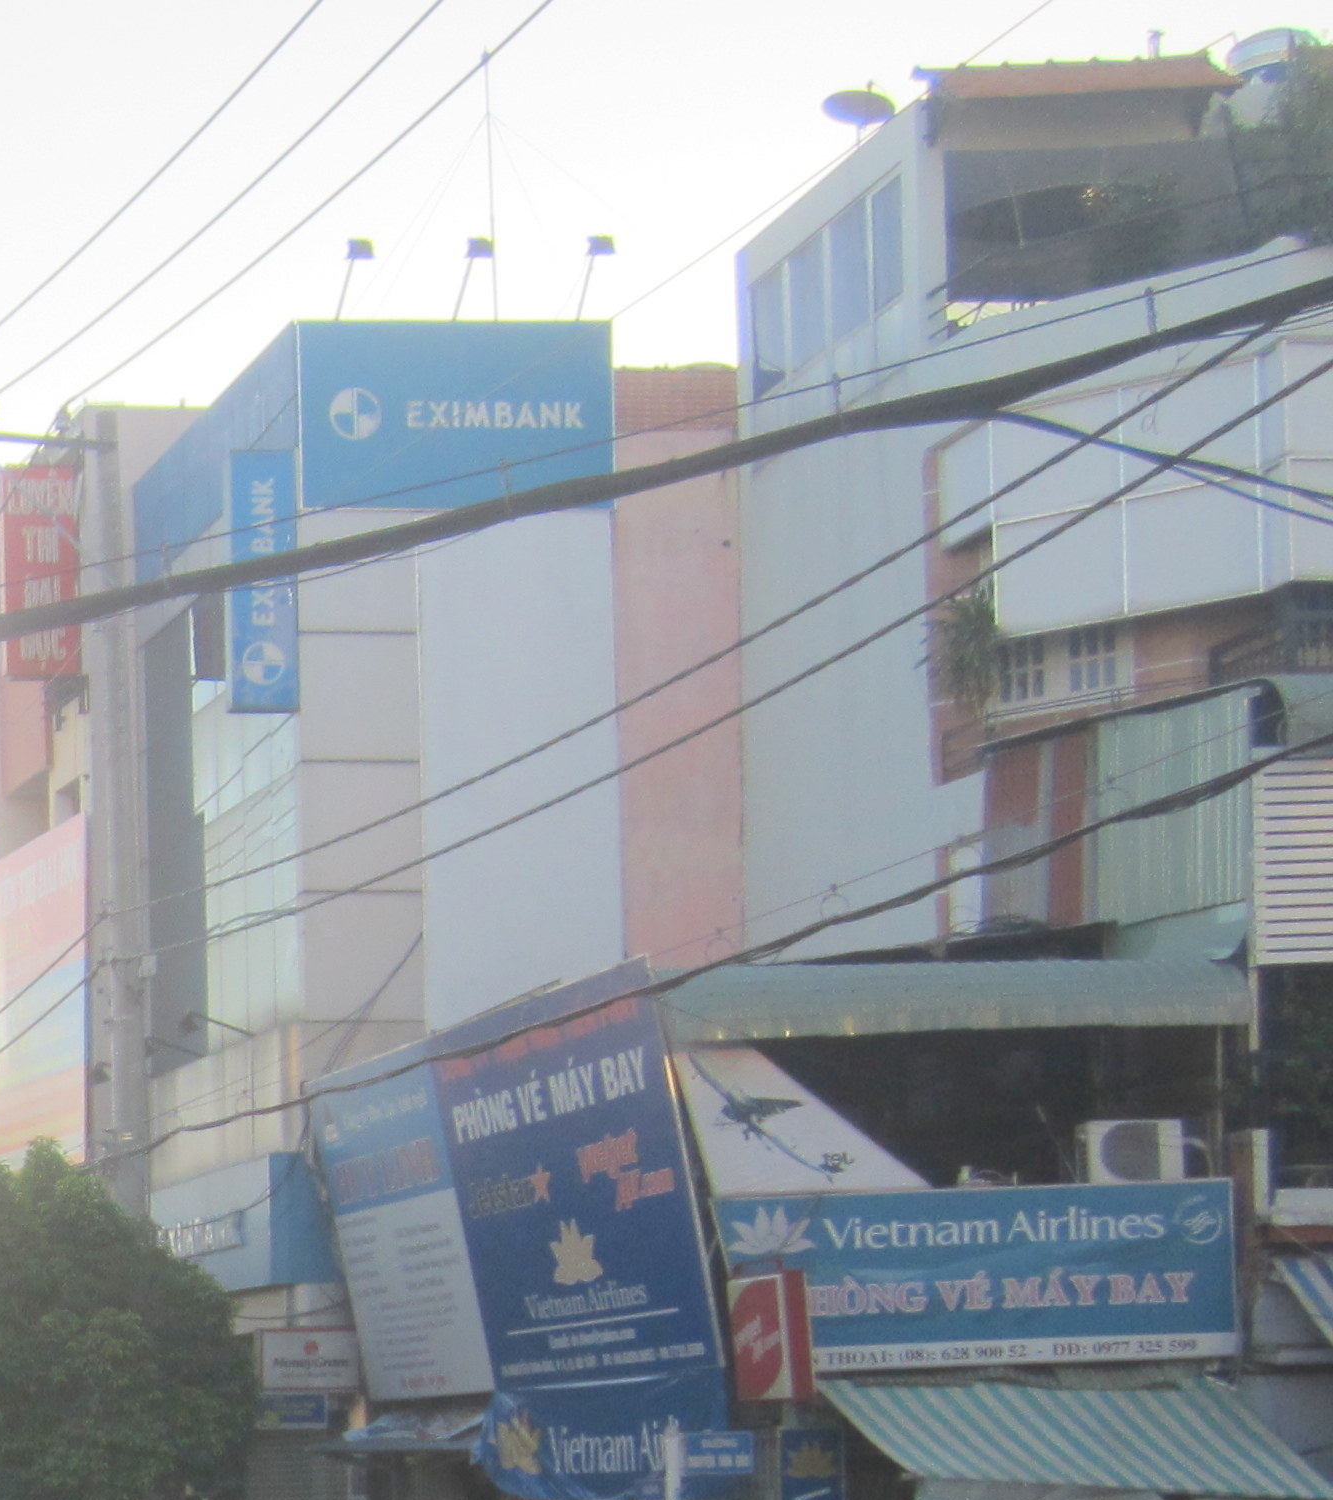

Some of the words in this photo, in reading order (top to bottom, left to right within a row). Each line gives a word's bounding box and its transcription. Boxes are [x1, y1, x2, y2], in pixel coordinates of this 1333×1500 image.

[406, 400, 584, 428] EXIMBANK
[250, 477, 276, 627] EXBANK
[452, 1089, 519, 1144] PHÒNG
[517, 1069, 547, 1125] VÉ
[548, 1057, 595, 1116] MÁY
[600, 1046, 645, 1101] BAY
[823, 1217, 999, 1249] Vietnam
[1007, 1206, 1165, 1243] Airlines
[525, 1293, 586, 1320] Vietnam
[588, 1280, 649, 1311] Airlines
[808, 1276, 929, 1316] HÒNG
[935, 1270, 993, 1312] VÉ
[1002, 1267, 1101, 1310] MÁY
[1108, 1272, 1194, 1306] BAY
[941, 1347, 969, 1361] 628
[974, 1345, 1002, 1358] 900
[1008, 1344, 1027, 1358] 52
[1092, 1341, 1130, 1355] 0977
[546, 1424, 636, 1474] Vietnam
